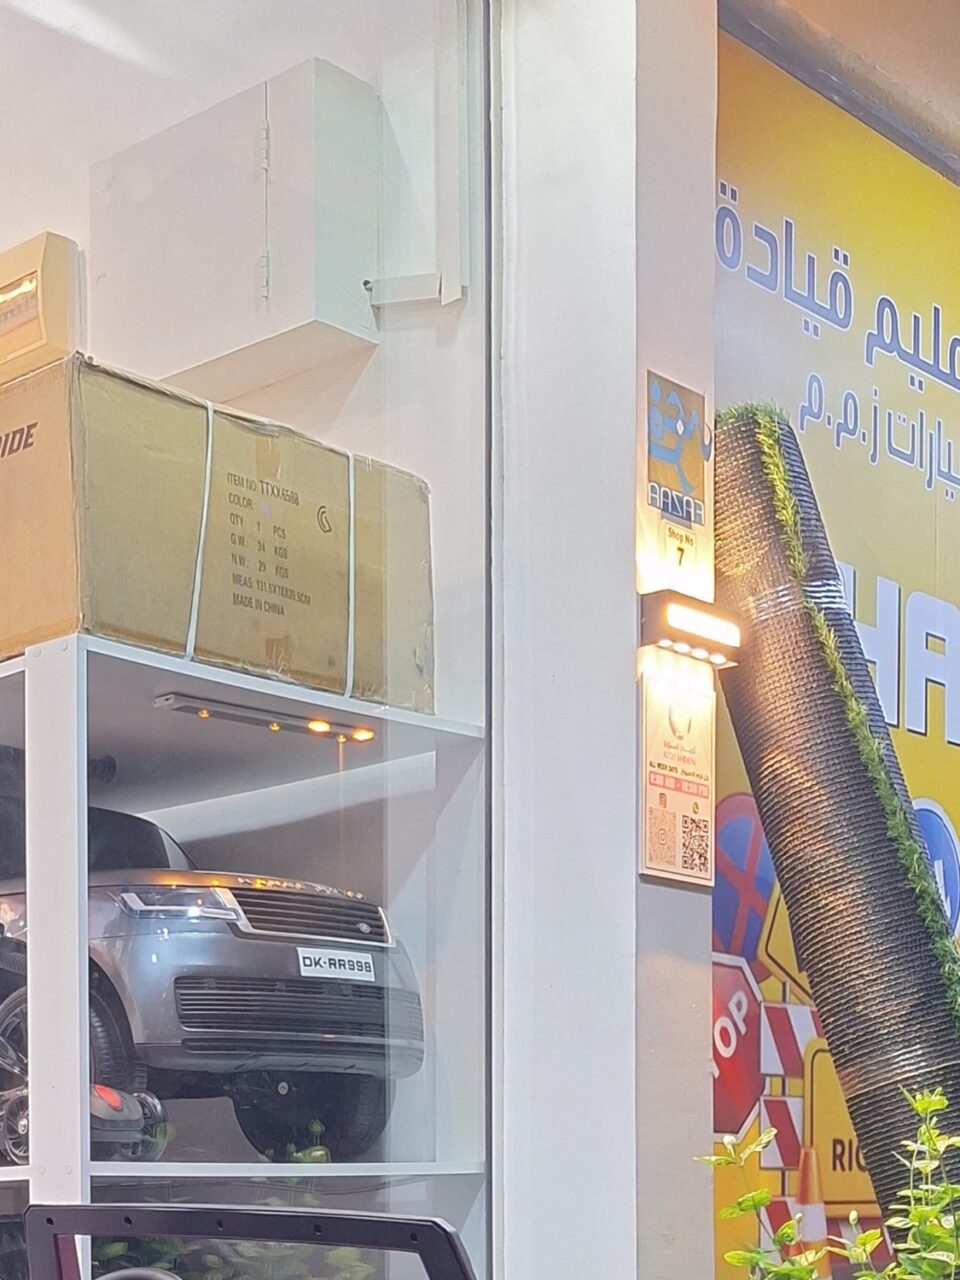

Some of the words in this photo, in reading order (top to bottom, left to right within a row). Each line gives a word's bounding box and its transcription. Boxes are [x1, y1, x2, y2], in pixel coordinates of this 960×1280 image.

[715, 180, 853, 339] قيادة
[886, 408, 960, 500] يارات
[227, 472, 245, 487] ITEM
[273, 525, 286, 540] PCS
[668, 527, 684, 544] Shop
[274, 546, 288, 560] KGS
[677, 547, 685, 566] 7
[232, 593, 254, 609] MADE
[255, 600, 263, 612] IN
[264, 602, 285, 616] CHINA
[712, 990, 749, 1079] OP
